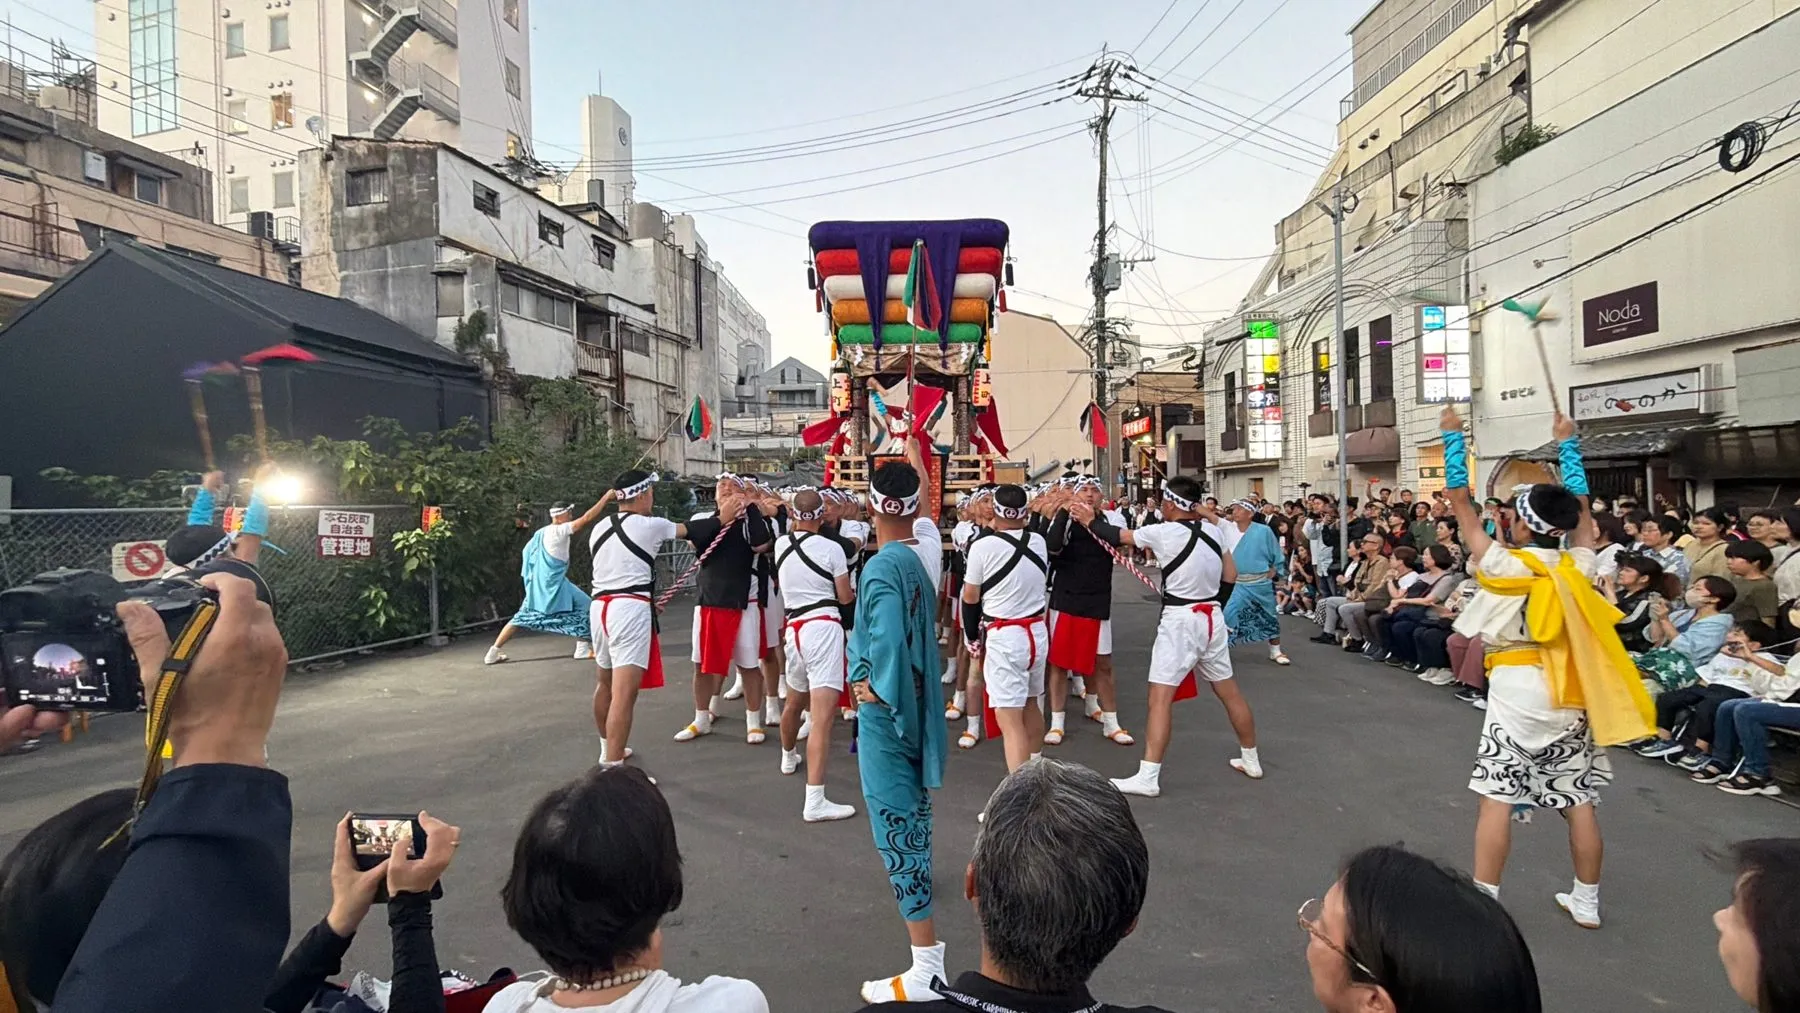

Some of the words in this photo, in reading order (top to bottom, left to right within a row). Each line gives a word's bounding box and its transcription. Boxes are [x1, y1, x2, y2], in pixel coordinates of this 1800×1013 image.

[1598, 299, 1640, 325] Noda
[324, 512, 370, 524] 本石灰町
[331, 524, 364, 535] 自治会
[321, 537, 371, 555] 管理地
